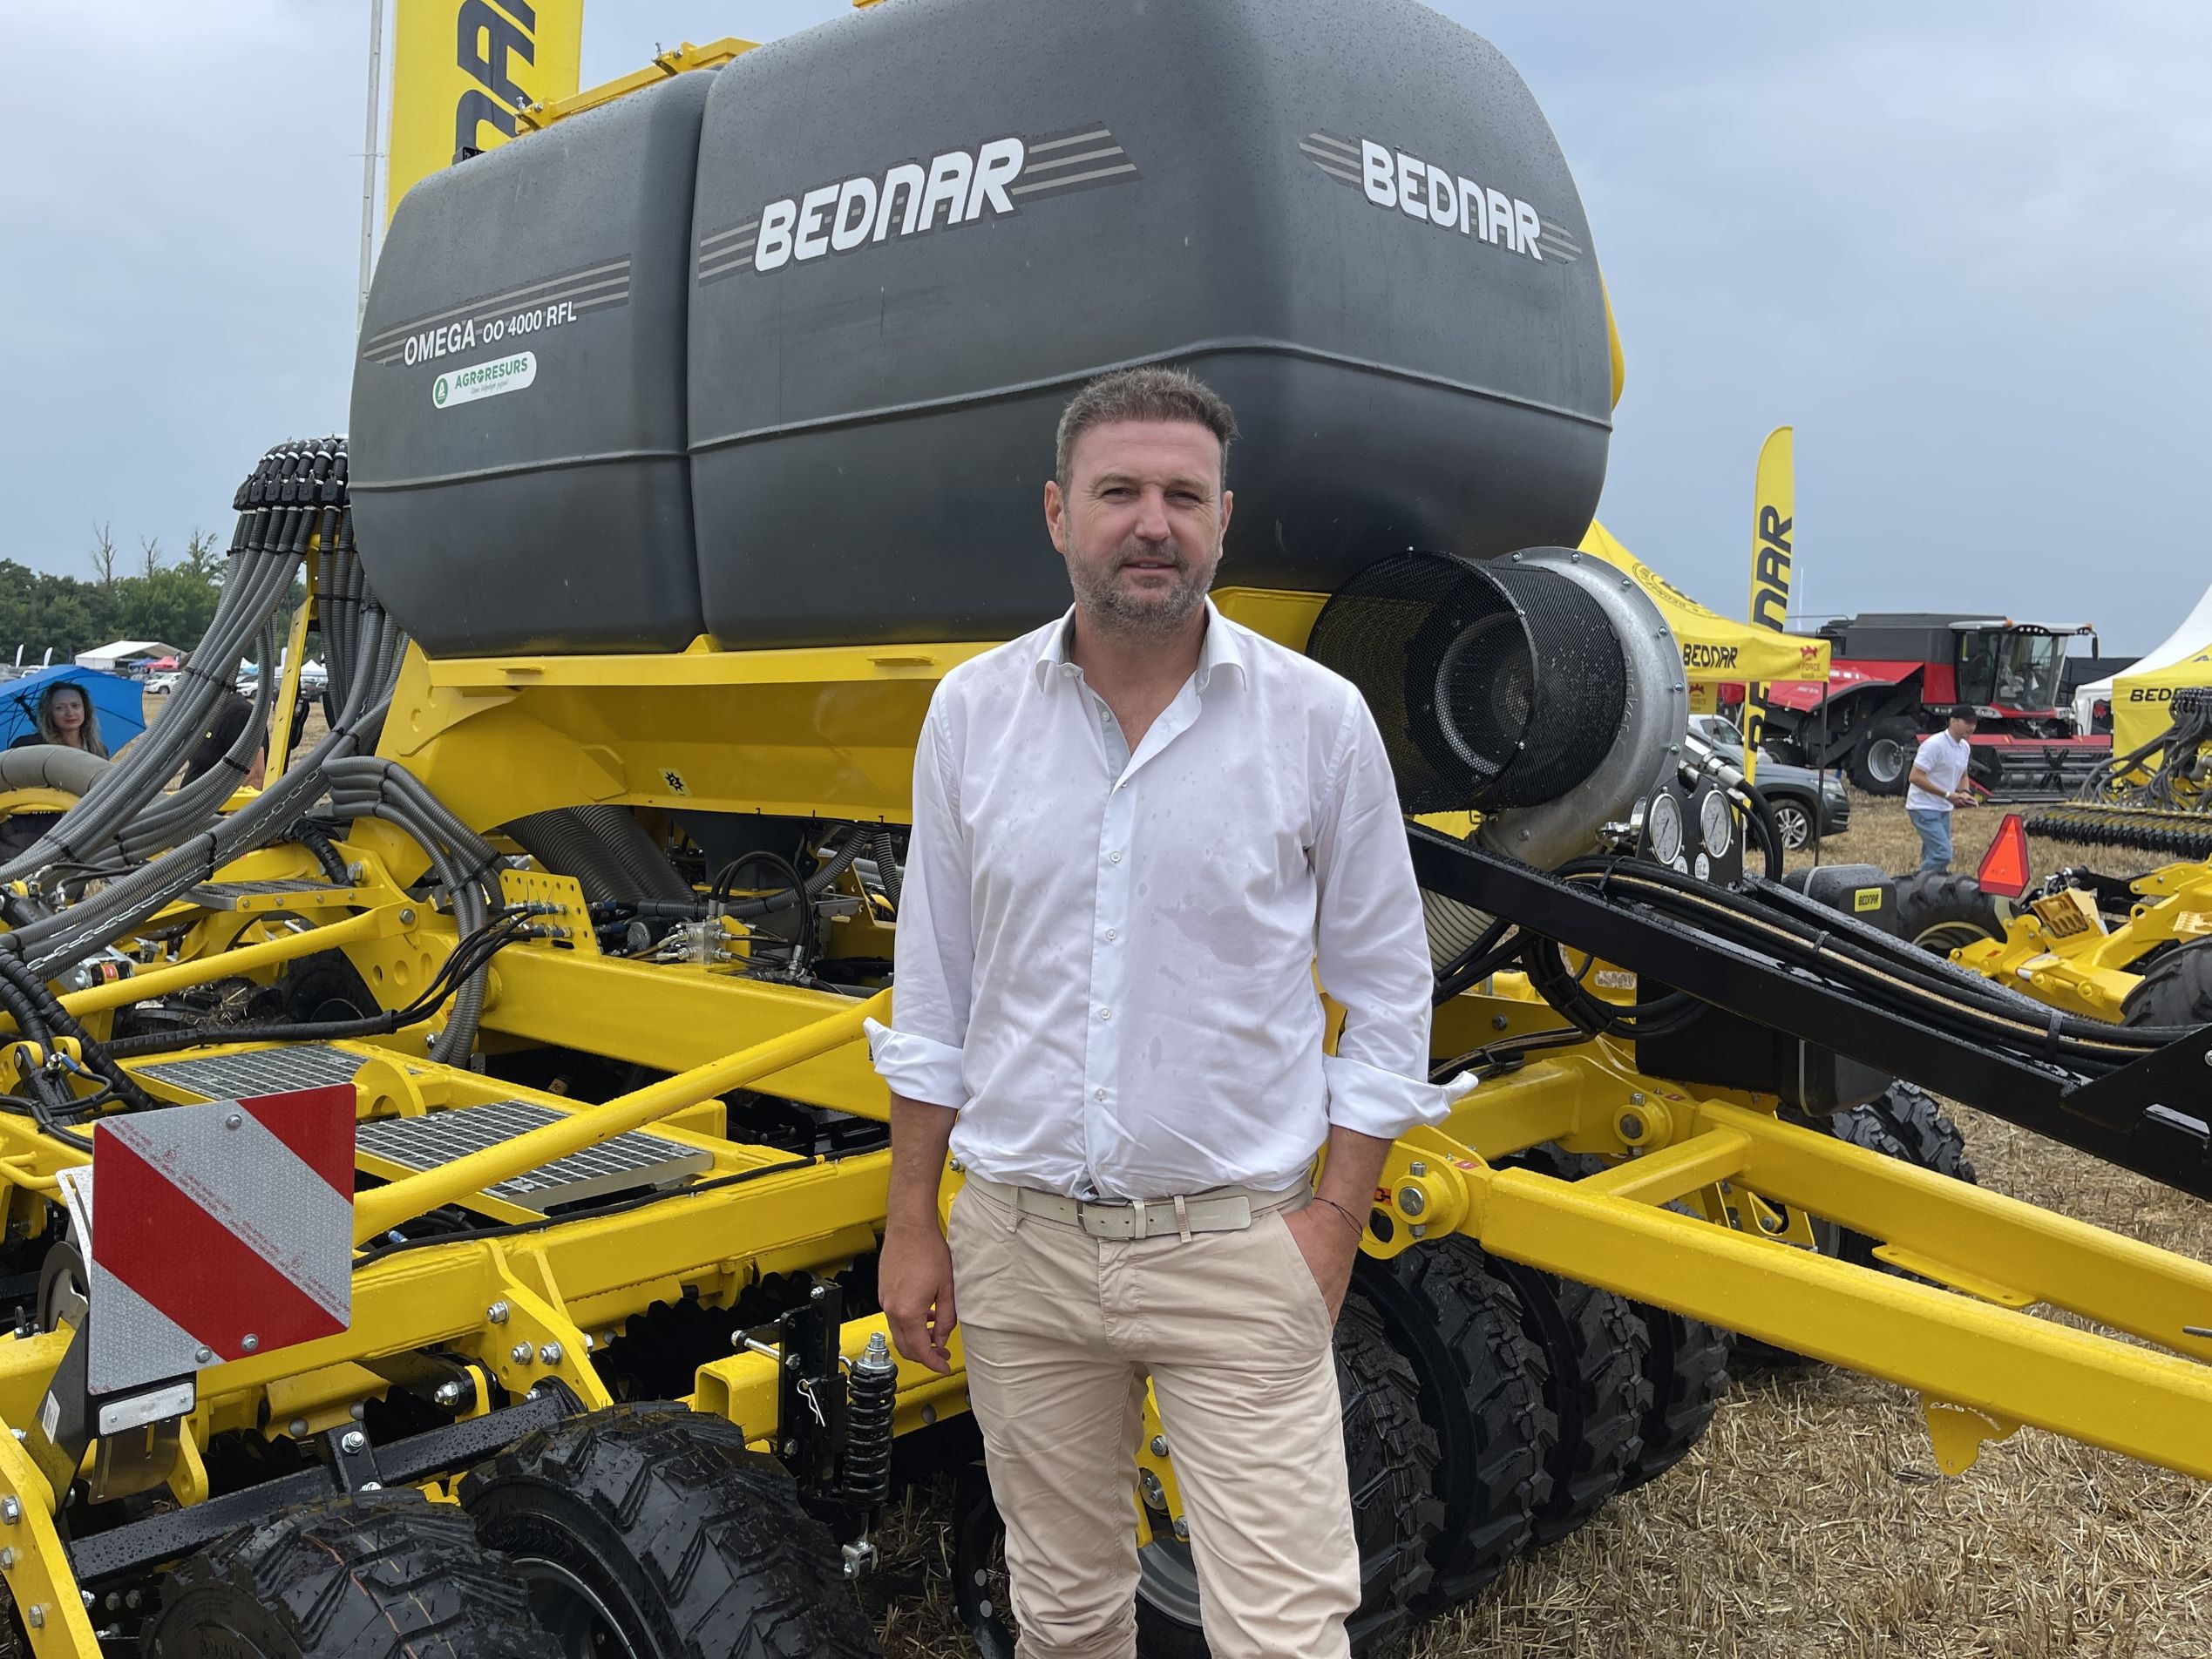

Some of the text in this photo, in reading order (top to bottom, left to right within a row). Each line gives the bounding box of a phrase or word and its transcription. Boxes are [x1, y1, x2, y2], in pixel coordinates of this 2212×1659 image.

[755, 137, 1025, 272] BEDNAR
[1361, 139, 1543, 261] BEDNAR
[404, 319, 476, 366] OMEGA
[507, 309, 543, 336] 4000
[546, 301, 578, 328] RFL
[454, 357, 528, 389] AGRORESURS
[1682, 643, 1739, 669] BEDNAR
[1747, 504, 1793, 754] BENAR
[1858, 893, 1879, 906] BEDNAR
